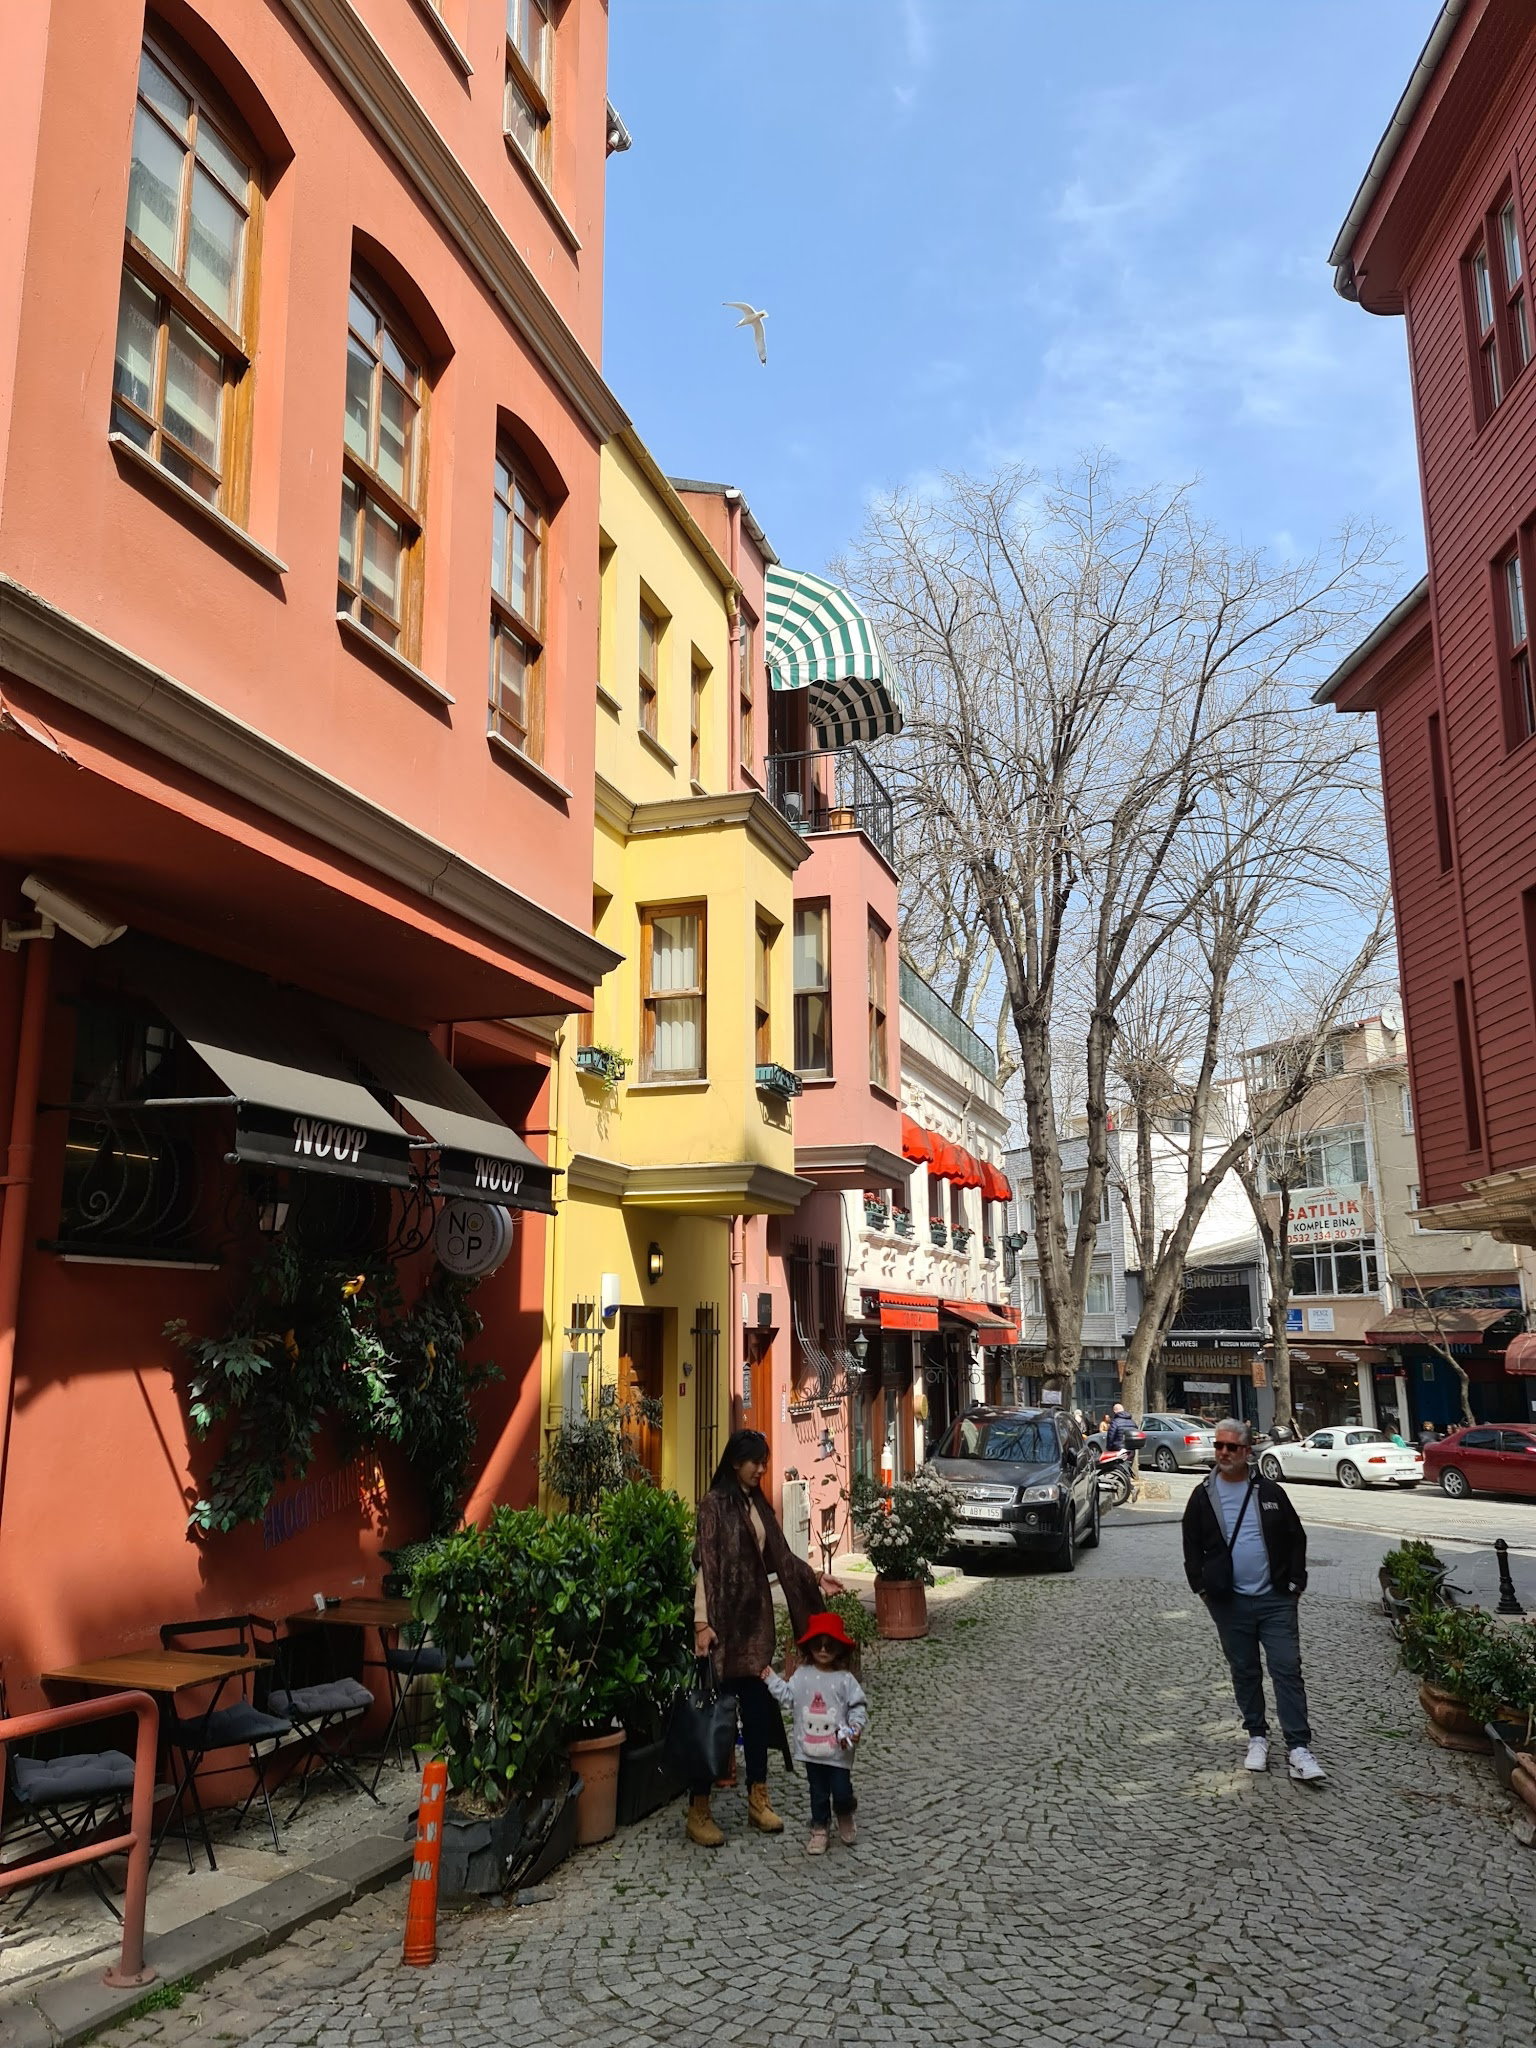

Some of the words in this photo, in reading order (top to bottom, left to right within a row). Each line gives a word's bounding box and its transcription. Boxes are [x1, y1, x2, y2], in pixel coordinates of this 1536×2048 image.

[292, 1116, 368, 1164] NOOP
[474, 1156, 525, 1196] NOOP
[449, 1211, 484, 1235] NO
[1293, 1219, 1331, 1233] KOMPLE
[1332, 1216, 1357, 1228] BİNA
[1287, 1233, 1310, 1244] 0532
[1313, 1231, 1332, 1241] 334
[1334, 1229, 1347, 1239] 30
[1350, 1227, 1362, 1238] 97
[1160, 1352, 1195, 1367] UZGUN
[969, 1507, 983, 1516] ABY
[987, 1508, 1000, 1518] 155
